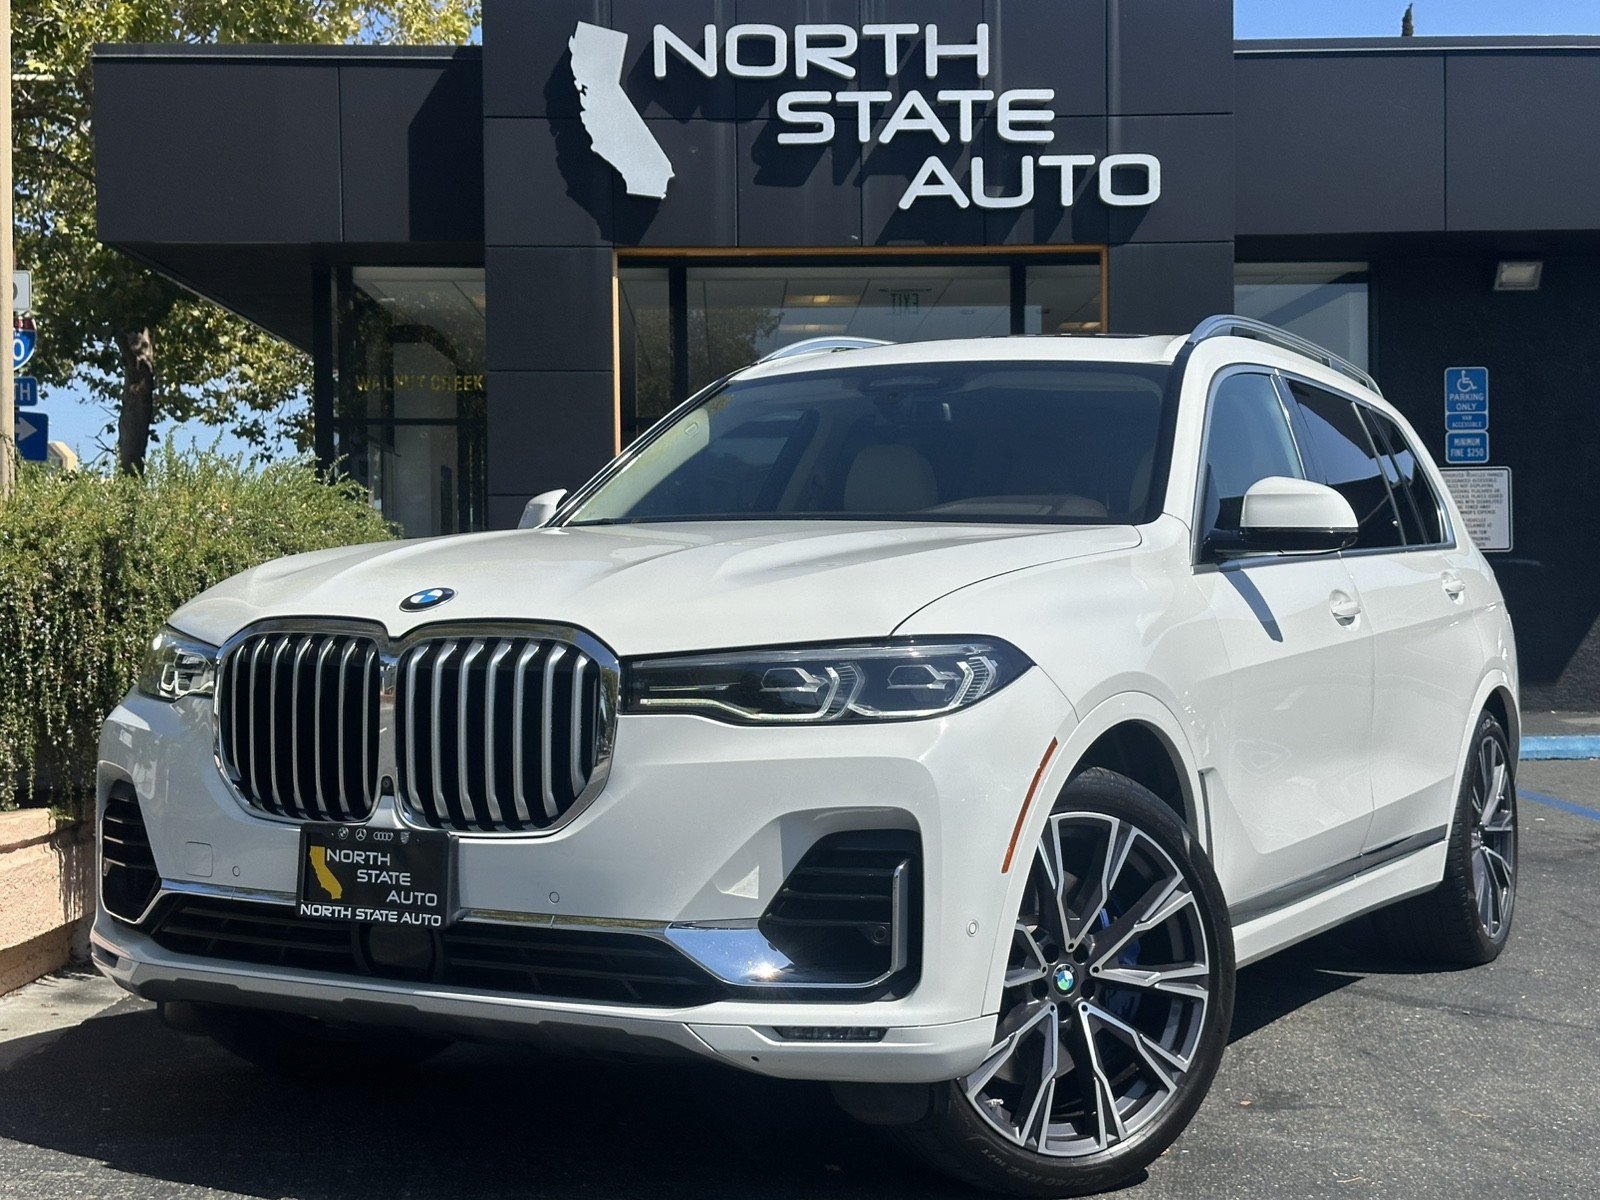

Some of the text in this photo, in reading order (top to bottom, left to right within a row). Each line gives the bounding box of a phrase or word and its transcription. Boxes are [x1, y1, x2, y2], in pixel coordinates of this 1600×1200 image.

[653, 23, 989, 79] NORTH
[777, 89, 1055, 145] STATE
[898, 153, 1161, 210] AUTO
[430, 374, 485, 392] CREEK
[1449, 393, 1484, 401] PARKING
[1456, 403, 1477, 411] ONLY
[1454, 438, 1480, 447] MINIMUM
[1450, 448, 1484, 457] FINE $250
[327, 848, 390, 866] NORTH
[357, 869, 411, 886] STATE
[386, 889, 438, 906] AUTO
[300, 903, 442, 927] NORTH STATE AUTO
